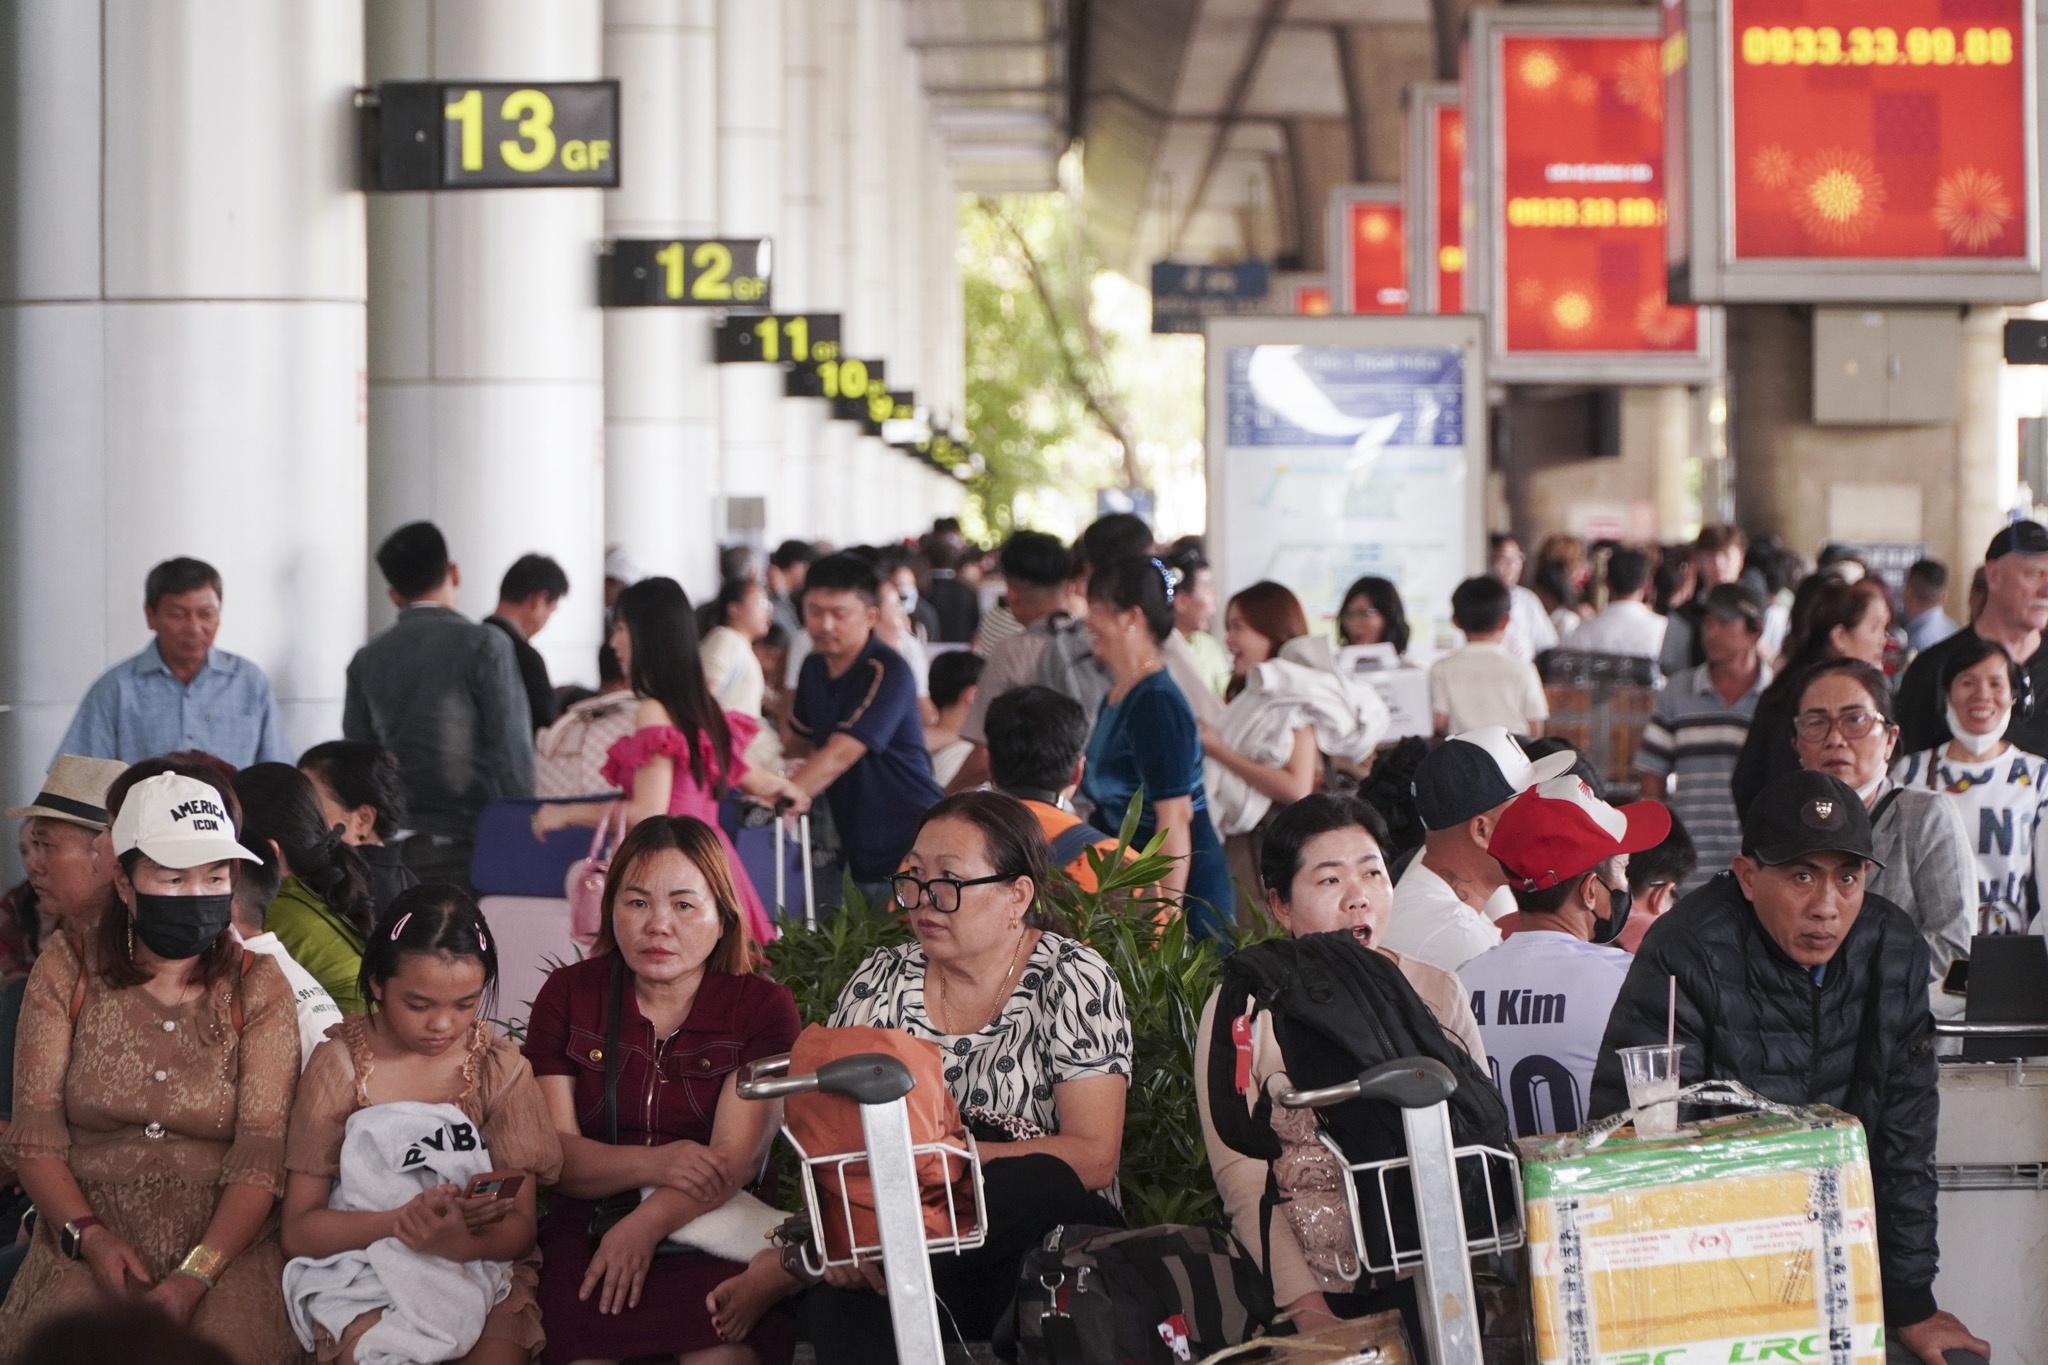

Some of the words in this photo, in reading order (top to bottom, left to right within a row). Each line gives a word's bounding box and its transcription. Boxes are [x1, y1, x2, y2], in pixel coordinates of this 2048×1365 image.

[445, 89, 556, 172] 13
[560, 139, 612, 171] GF
[655, 241, 733, 300] 12
[754, 316, 808, 363] 11
[816, 359, 868, 398] 10
[193, 819, 219, 831] ICON
[1497, 989, 1566, 1025] Kim
